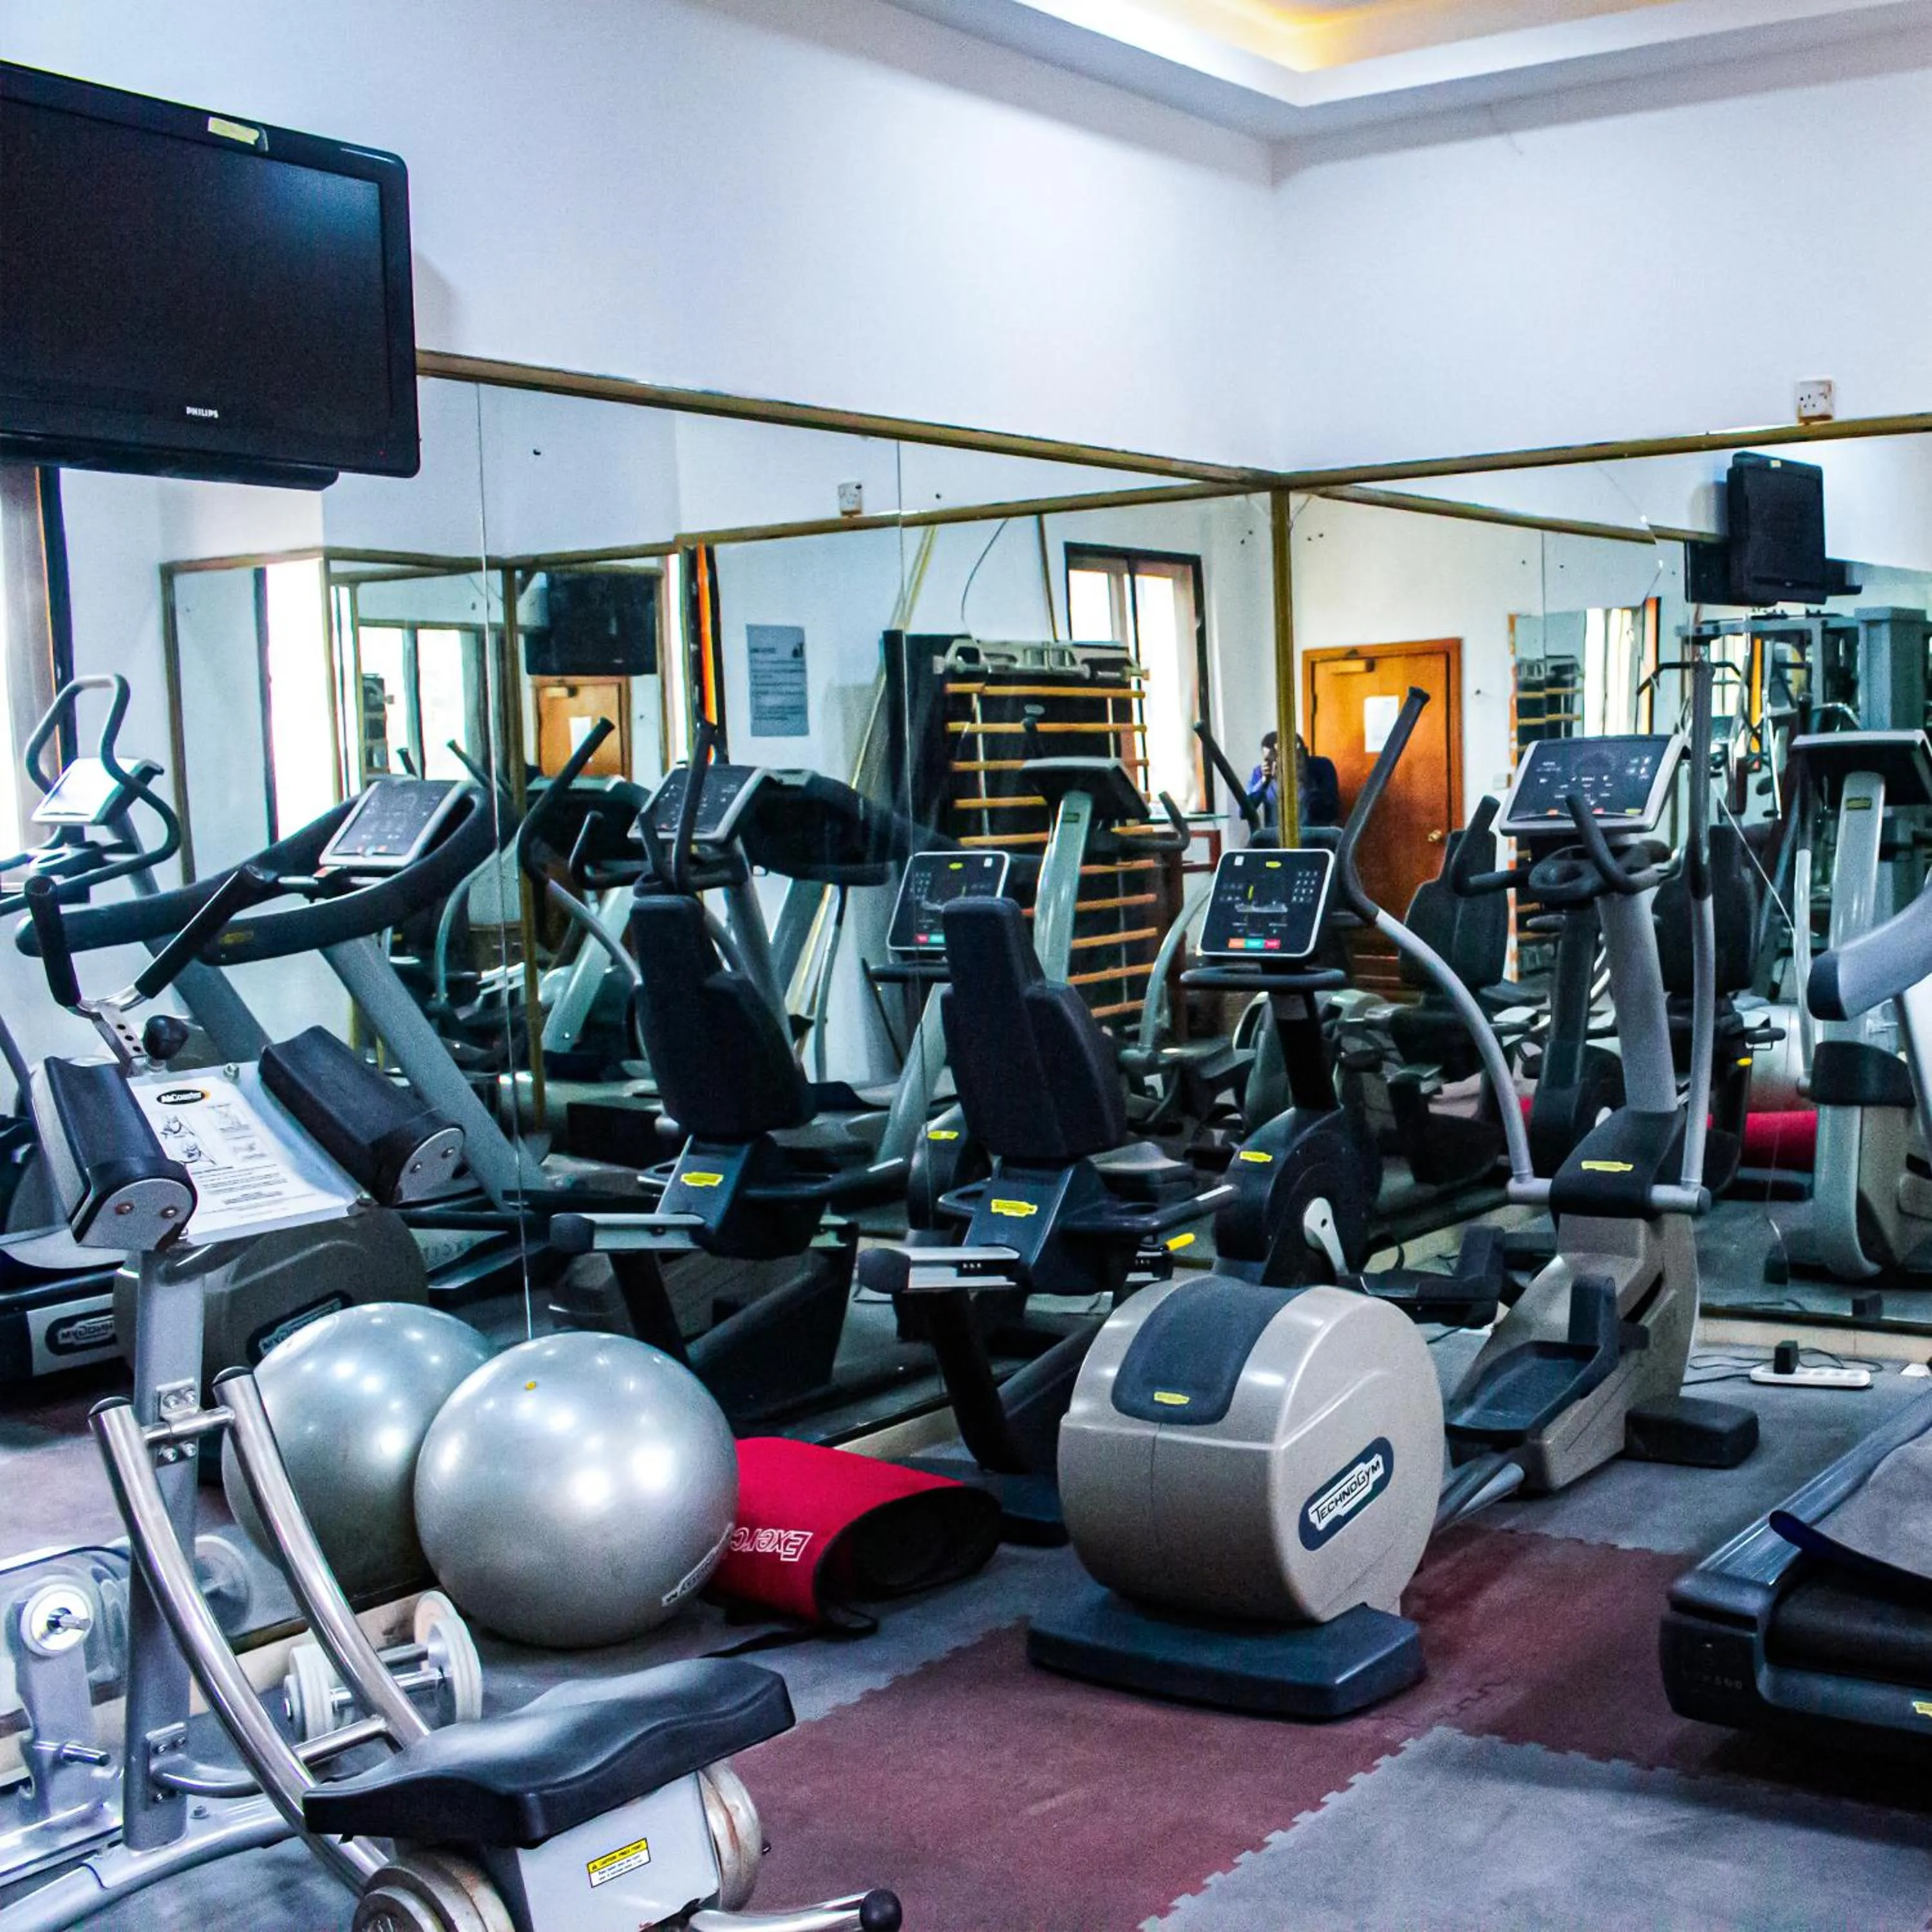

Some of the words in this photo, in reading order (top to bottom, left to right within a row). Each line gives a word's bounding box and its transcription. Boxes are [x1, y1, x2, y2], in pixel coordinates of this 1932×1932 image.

[186, 406, 219, 419] PHILIPS
[1311, 1460, 1381, 1524] TECHNOGYM
[731, 1527, 813, 1562] Exerc
